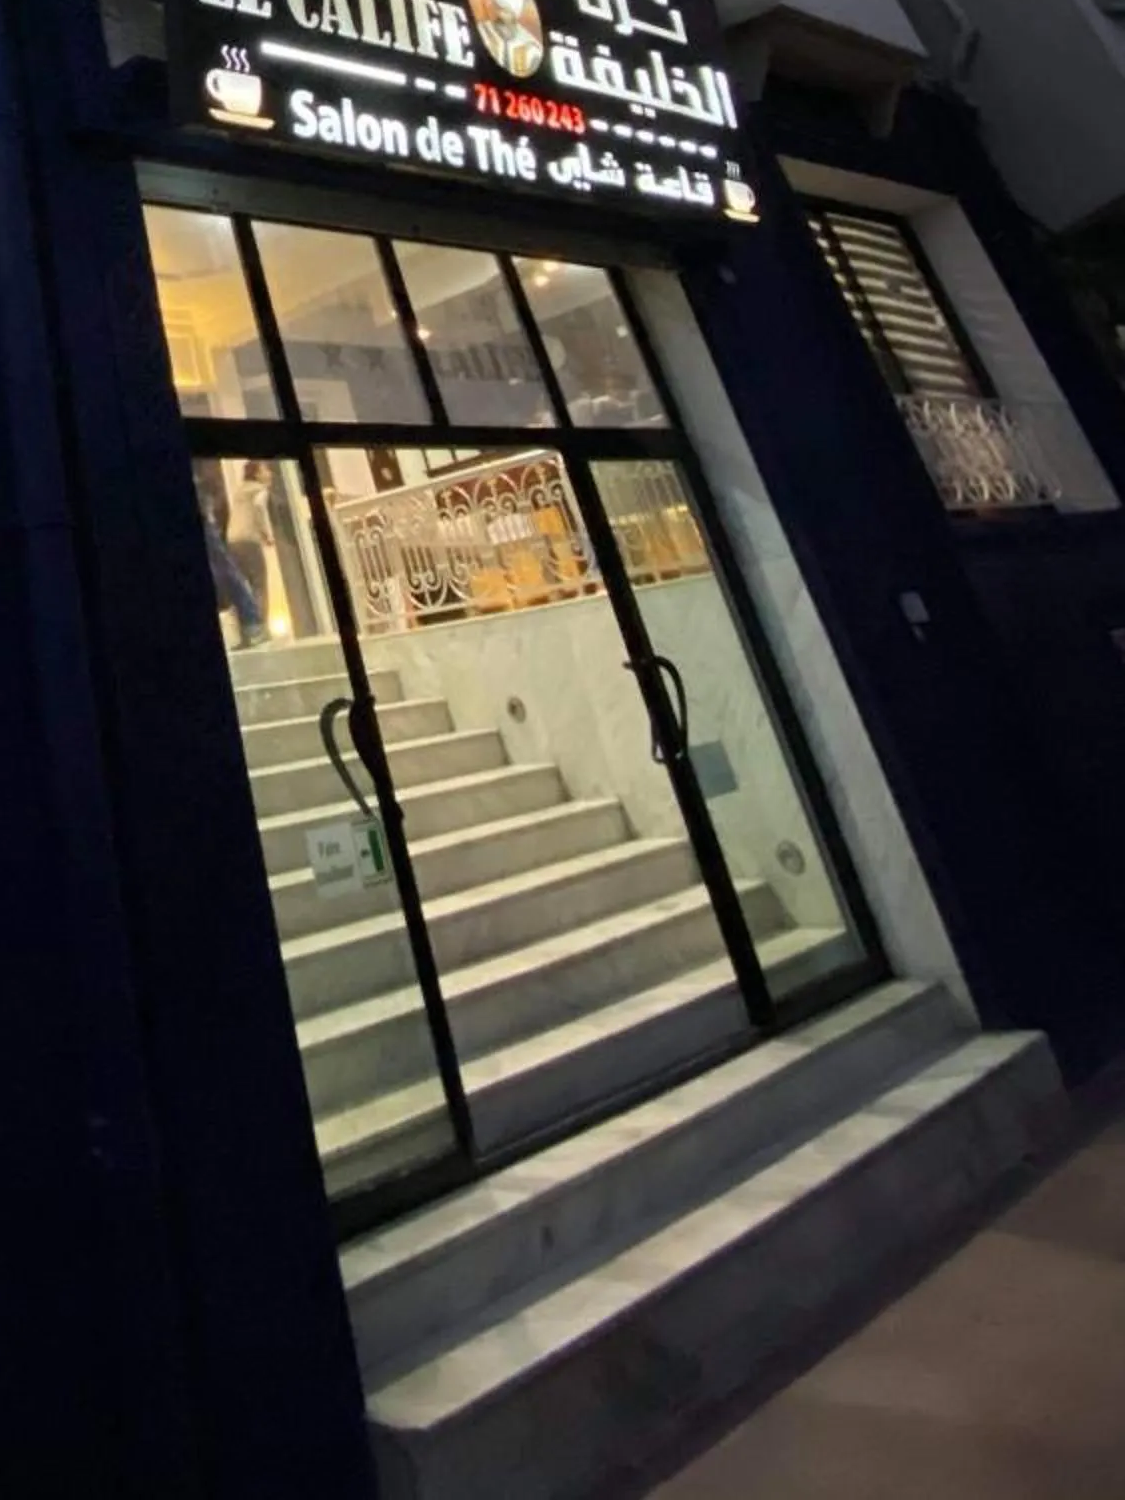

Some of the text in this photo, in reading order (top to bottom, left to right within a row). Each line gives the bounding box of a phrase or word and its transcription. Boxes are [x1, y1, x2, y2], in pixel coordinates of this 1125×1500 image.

[474, 83, 501, 115] 71
[549, 30, 738, 130] الخليفة
[289, 89, 537, 181] Salon de Thé
[546, 142, 714, 206] قاعة شاي
